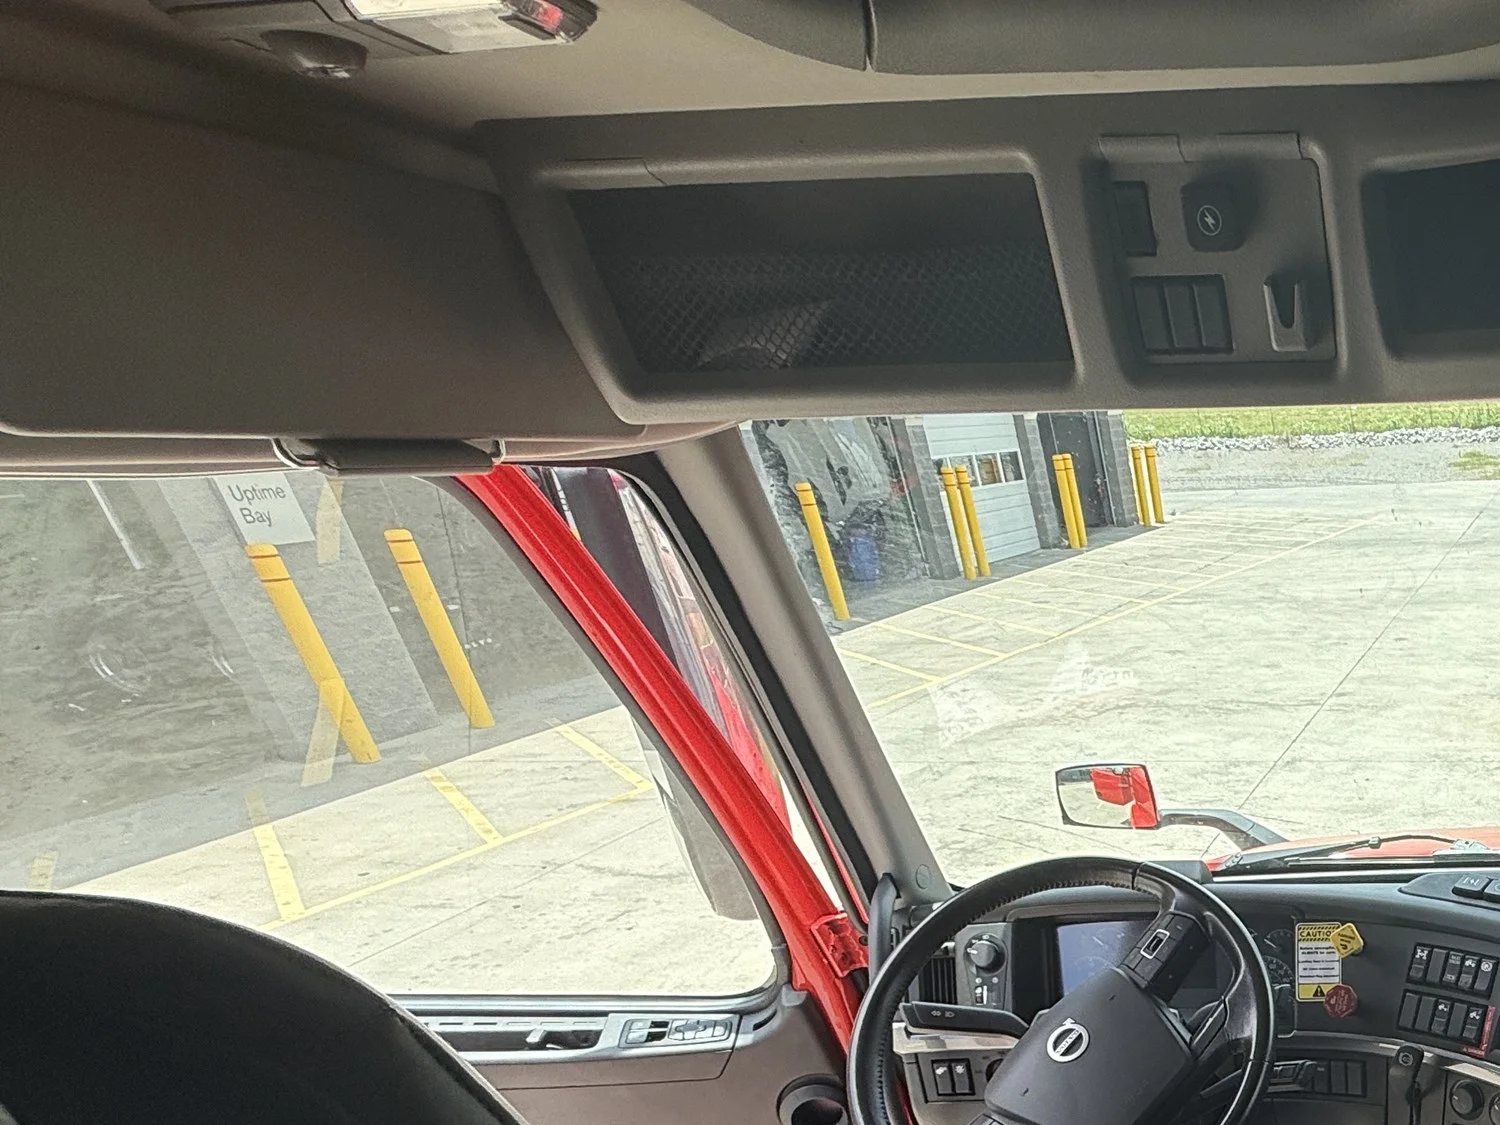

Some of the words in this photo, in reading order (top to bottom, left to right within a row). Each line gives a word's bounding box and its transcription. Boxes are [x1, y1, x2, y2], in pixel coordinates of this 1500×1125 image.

[227, 483, 286, 505] Uptime
[239, 507, 272, 527] Bay
[1299, 930, 1333, 938] CAUTIO
